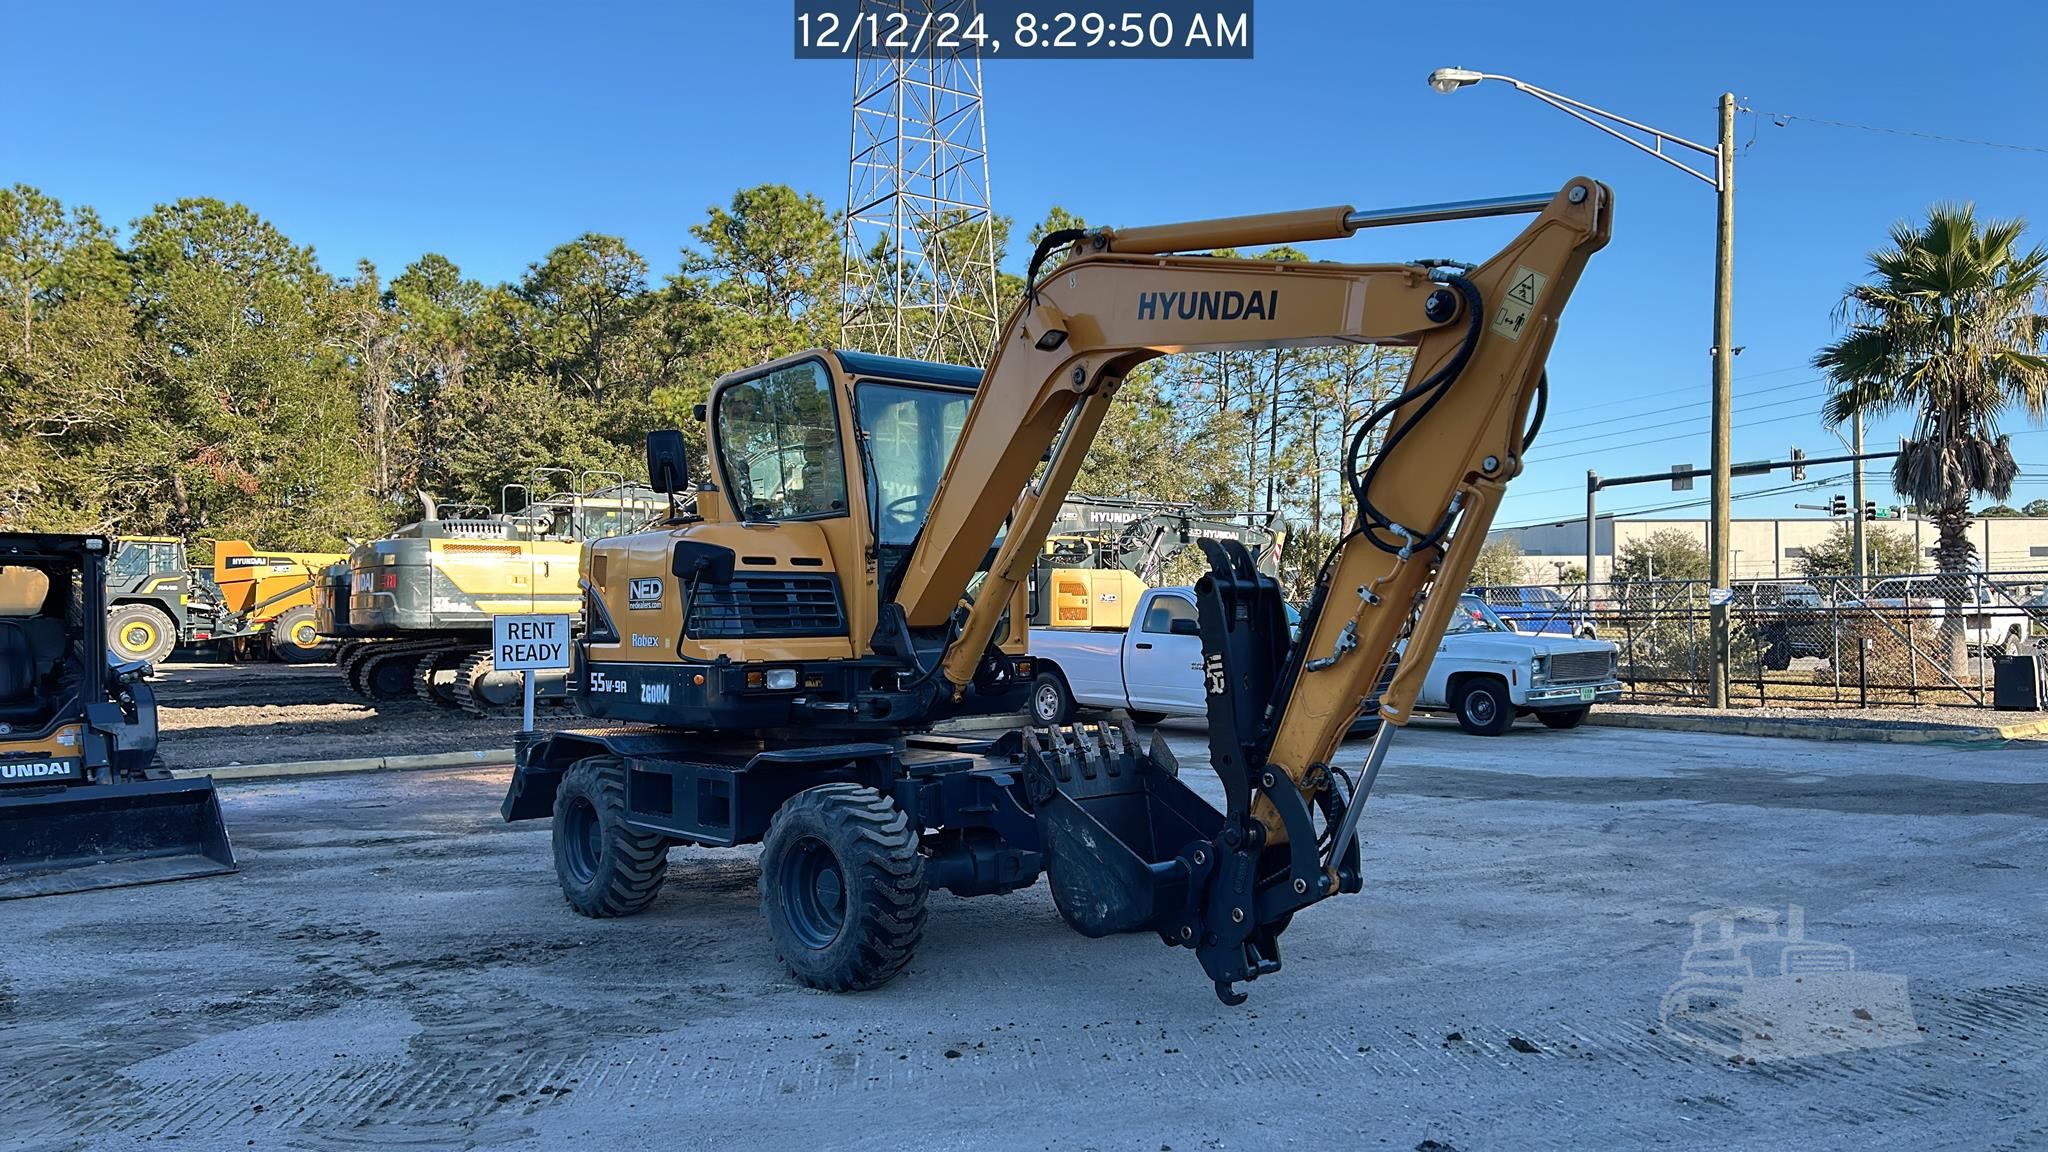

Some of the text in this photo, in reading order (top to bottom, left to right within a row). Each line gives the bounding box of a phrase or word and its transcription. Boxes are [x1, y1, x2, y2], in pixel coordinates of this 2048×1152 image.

[1137, 290, 1279, 321] HYUNDAI
[630, 579, 663, 600] NED
[629, 601, 662, 609] nedealers.com
[508, 621, 556, 640] RENT
[631, 633, 659, 647] Robex
[502, 643, 562, 662] READY
[0, 761, 71, 778] UNDAI
